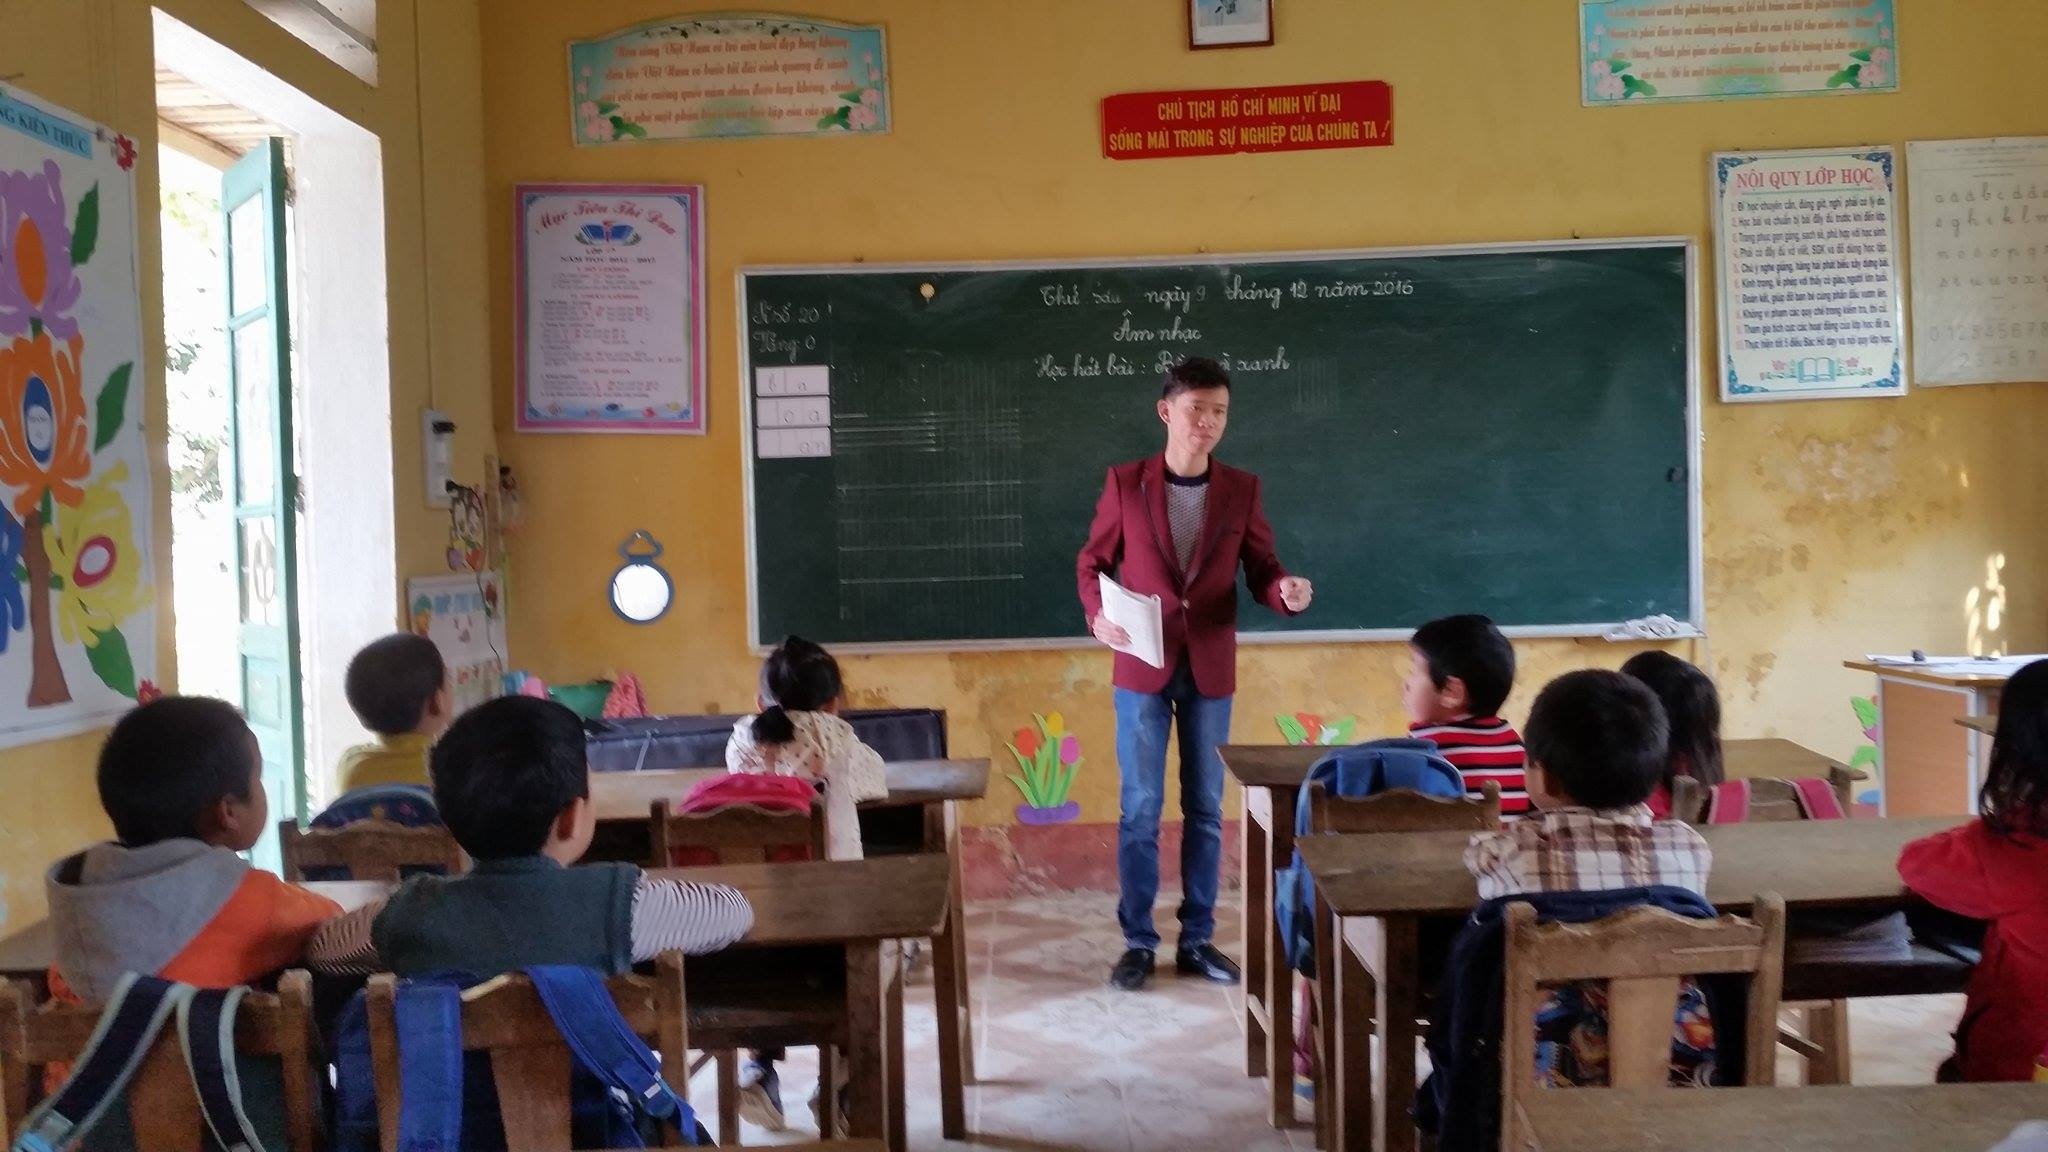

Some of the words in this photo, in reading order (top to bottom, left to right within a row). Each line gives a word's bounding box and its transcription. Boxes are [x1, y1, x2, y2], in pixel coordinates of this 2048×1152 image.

[1158, 97, 1183, 121] CHỦ
[1187, 100, 1216, 122] TỊCH
[1221, 93, 1239, 119] HỒ
[1243, 94, 1263, 117] CHÍ
[1267, 96, 1300, 116] MINH
[1320, 93, 1341, 115] ĐẠI
[1109, 126, 1143, 152] SỐNG
[1172, 128, 1214, 148] TRONG
[1219, 126, 1238, 149] SỰ
[1240, 122, 1286, 147] NGHIỆP
[1317, 118, 1359, 141] CHÚNG
[1362, 121, 1378, 139] TA
[1736, 169, 1764, 190] NỘI
[1769, 171, 1802, 189] QUY
[1807, 166, 1837, 186] LỚP
[1841, 167, 1873, 186] HỌC
[1040, 284, 1080, 306] Thứ
[1144, 285, 1191, 313] ngày
[1196, 285, 1206, 303] 9
[1225, 274, 1281, 310] tháng
[1315, 280, 1367, 298] năm
[1372, 279, 1414, 296] 2016
[1113, 309, 1155, 341] Âm
[1158, 315, 1202, 343] nhạc
[1072, 353, 1101, 377] hát
[1107, 352, 1136, 376] bài
[1237, 345, 1290, 370] xanh
